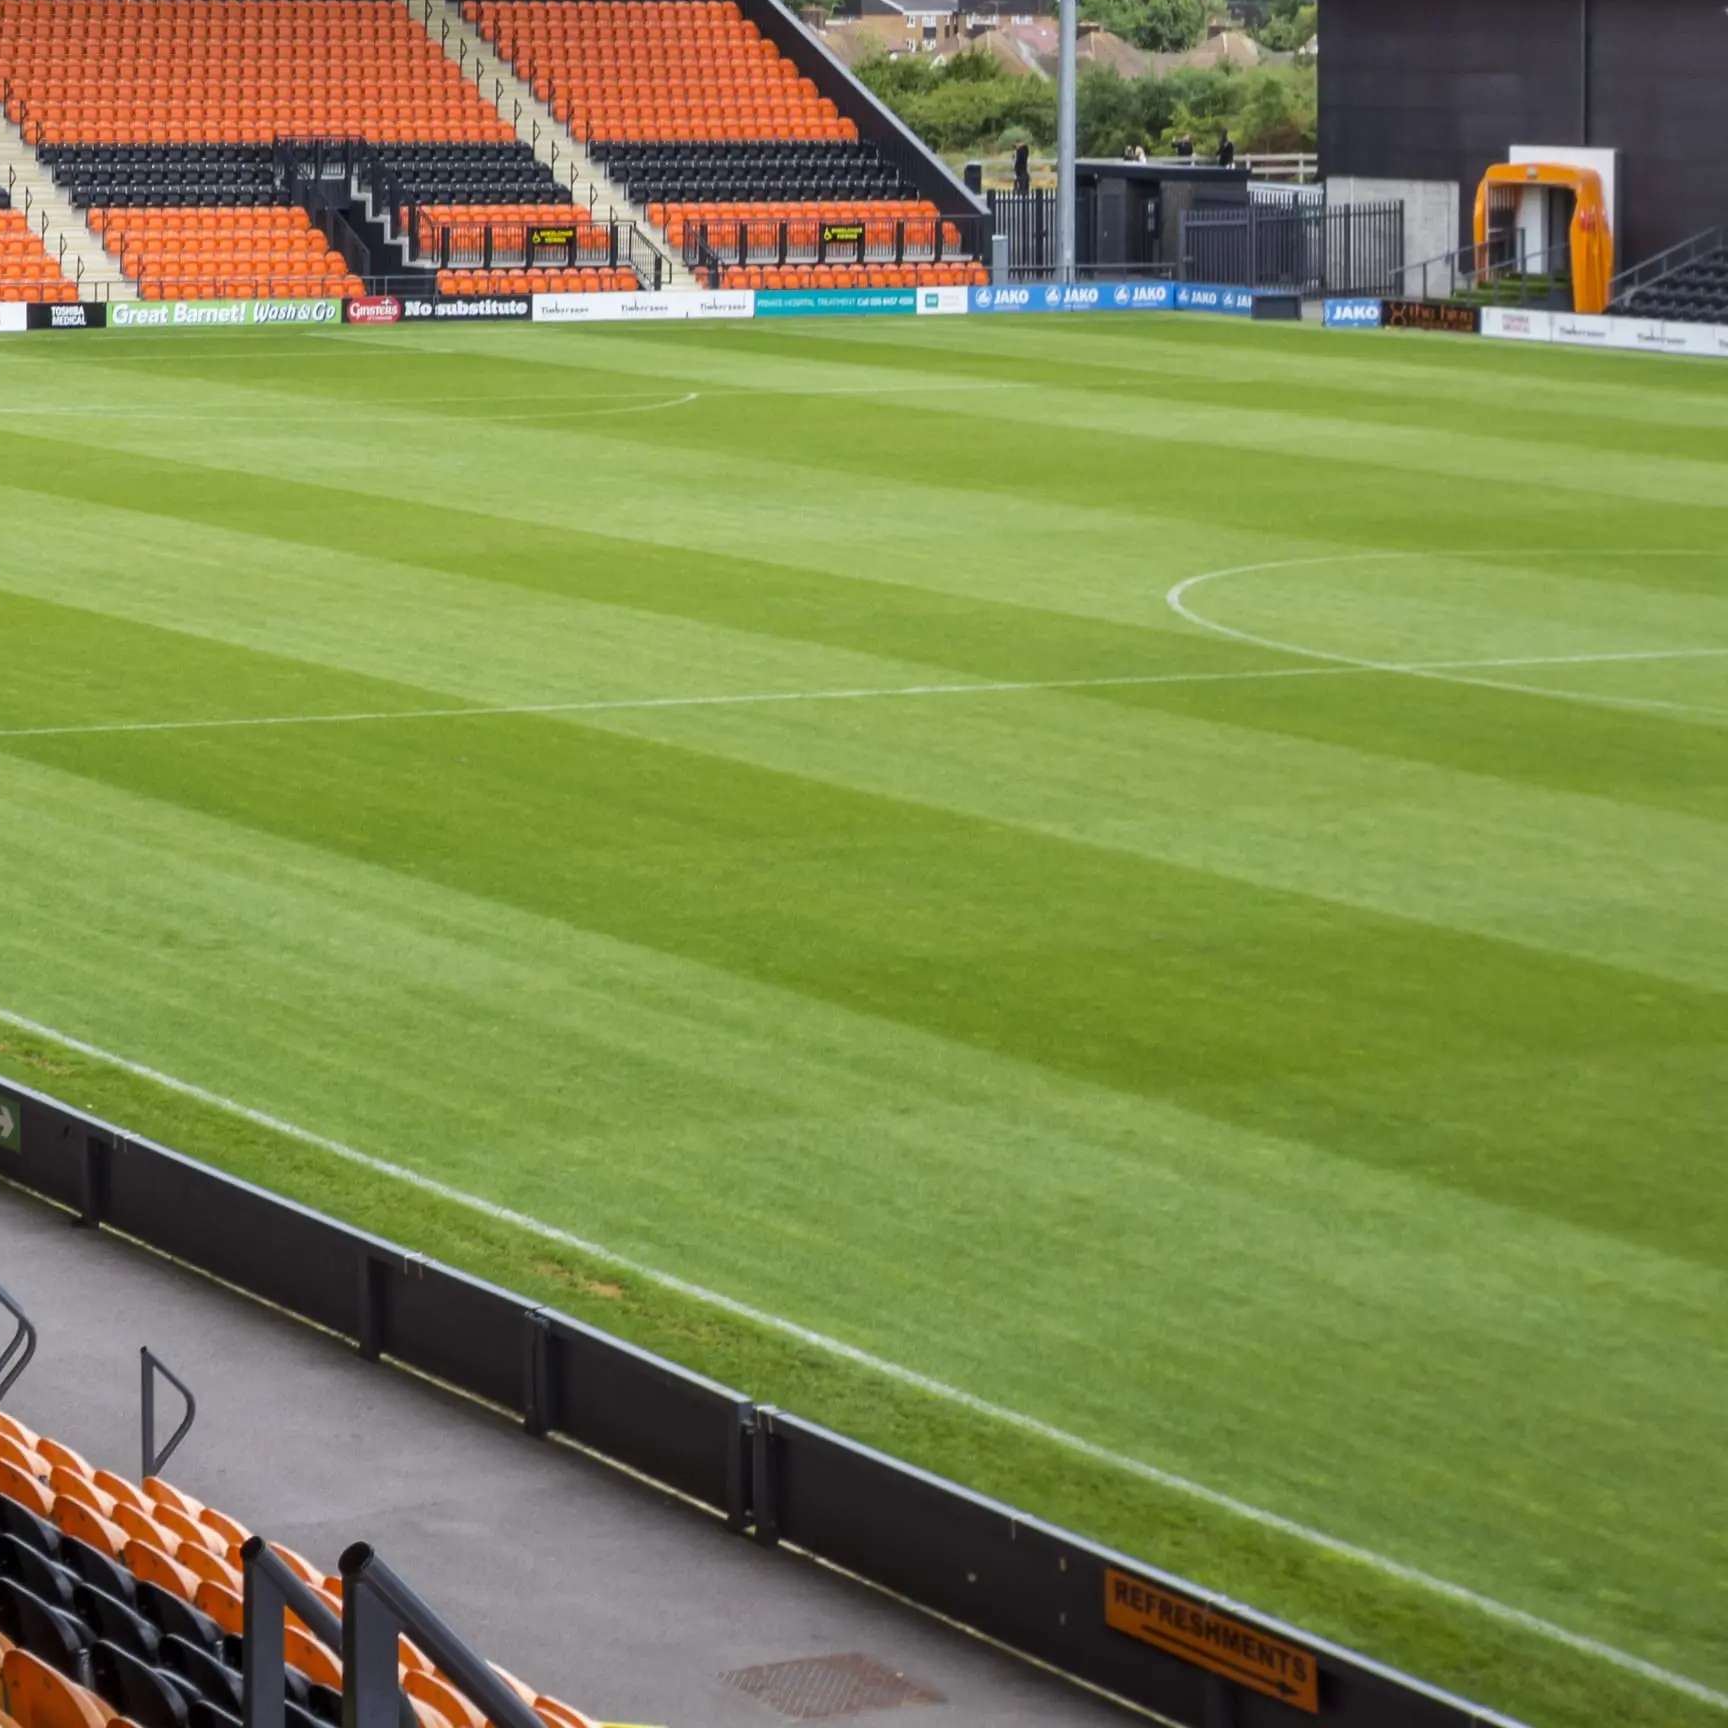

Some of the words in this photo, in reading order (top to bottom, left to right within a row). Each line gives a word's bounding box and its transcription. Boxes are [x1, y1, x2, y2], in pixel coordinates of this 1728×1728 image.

[994, 290, 1029, 305] JAKO
[1063, 288, 1098, 303] JAKO
[1131, 286, 1166, 301] JAKO
[1191, 291, 1216, 304] JAKO
[50, 306, 84, 316] TOSHIBA
[112, 303, 169, 325] Great
[173, 302, 247, 323] Barnet!
[404, 300, 432, 316] No
[434, 299, 528, 316] substitute
[1333, 306, 1379, 320] JAKO
[52, 316, 86, 326] MEDICAL
[1114, 1577, 1309, 1683] REFRESHMENTS
